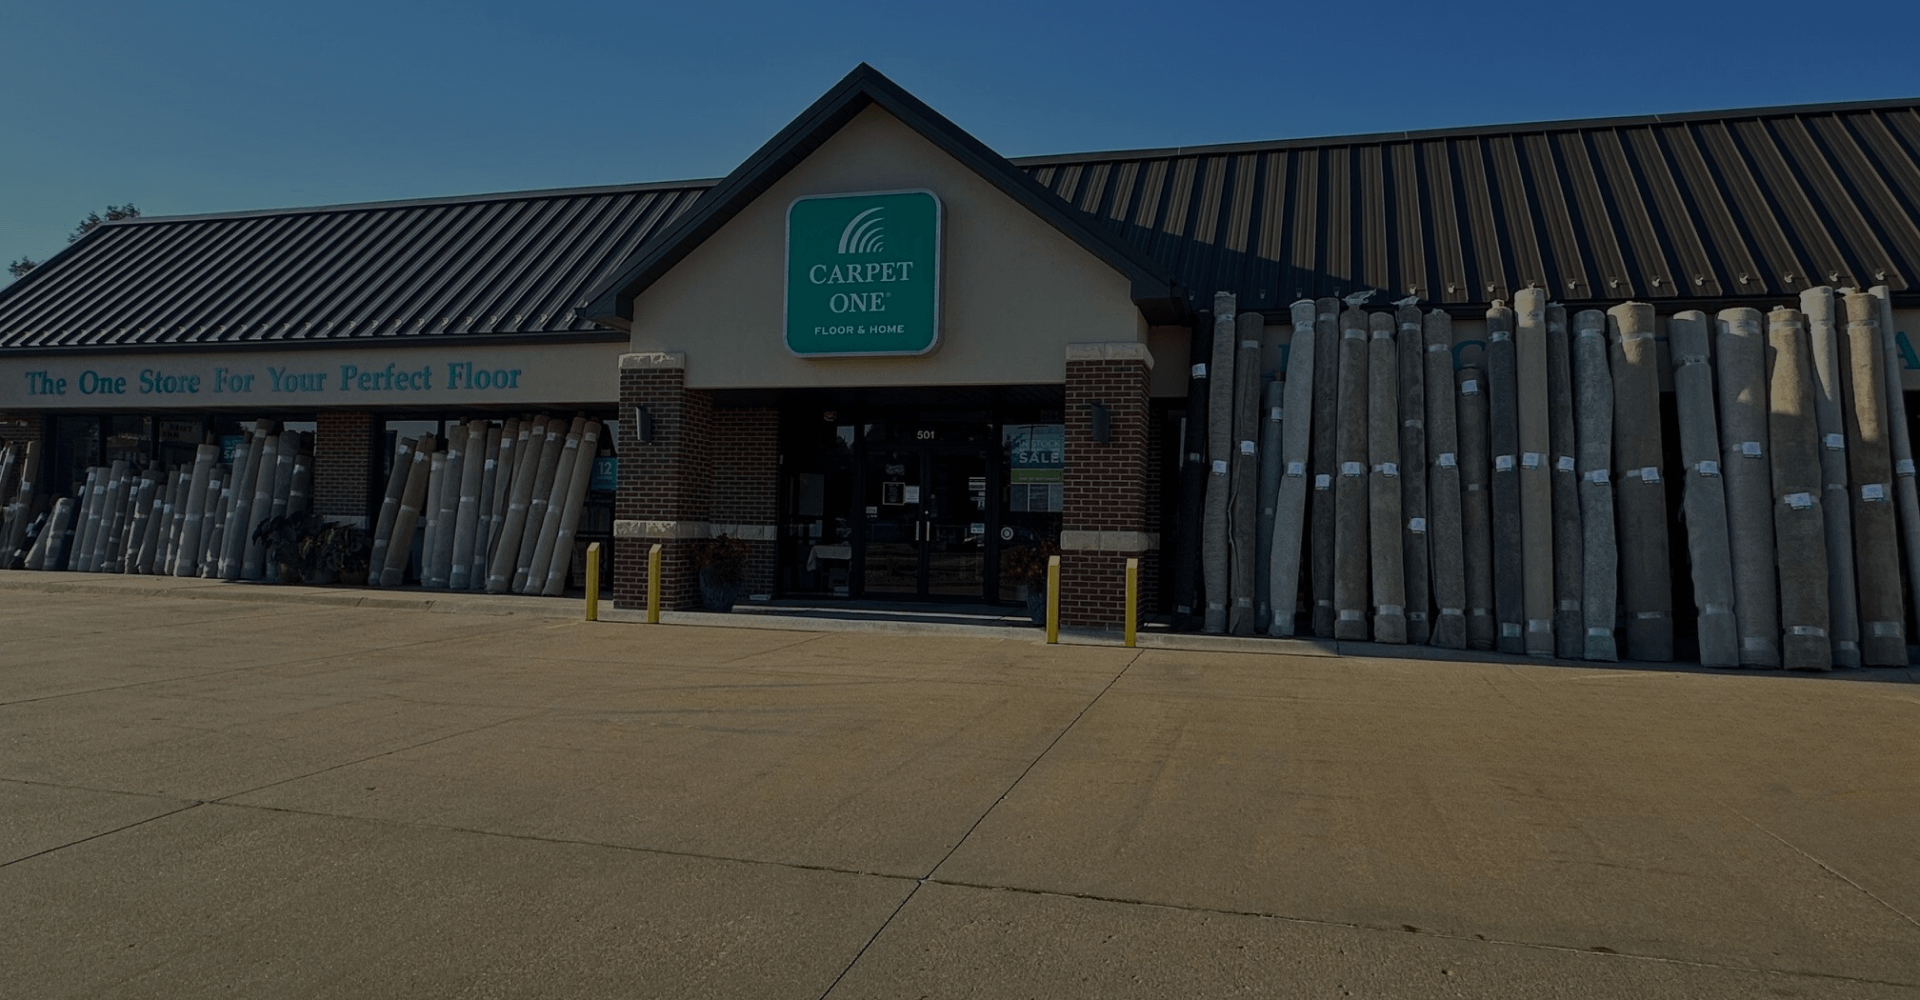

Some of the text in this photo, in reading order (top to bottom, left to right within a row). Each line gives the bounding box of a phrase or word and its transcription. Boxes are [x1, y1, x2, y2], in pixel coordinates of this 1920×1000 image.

[809, 261, 913, 285] CARPET
[814, 325, 904, 335] FLOOR & HOME
[25, 362, 522, 395] The One Store For Your Perfect Floor
[917, 430, 935, 439] 501
[1032, 440, 1060, 448] STOCK
[1019, 452, 1060, 463] SALE
[599, 461, 612, 475] 12
